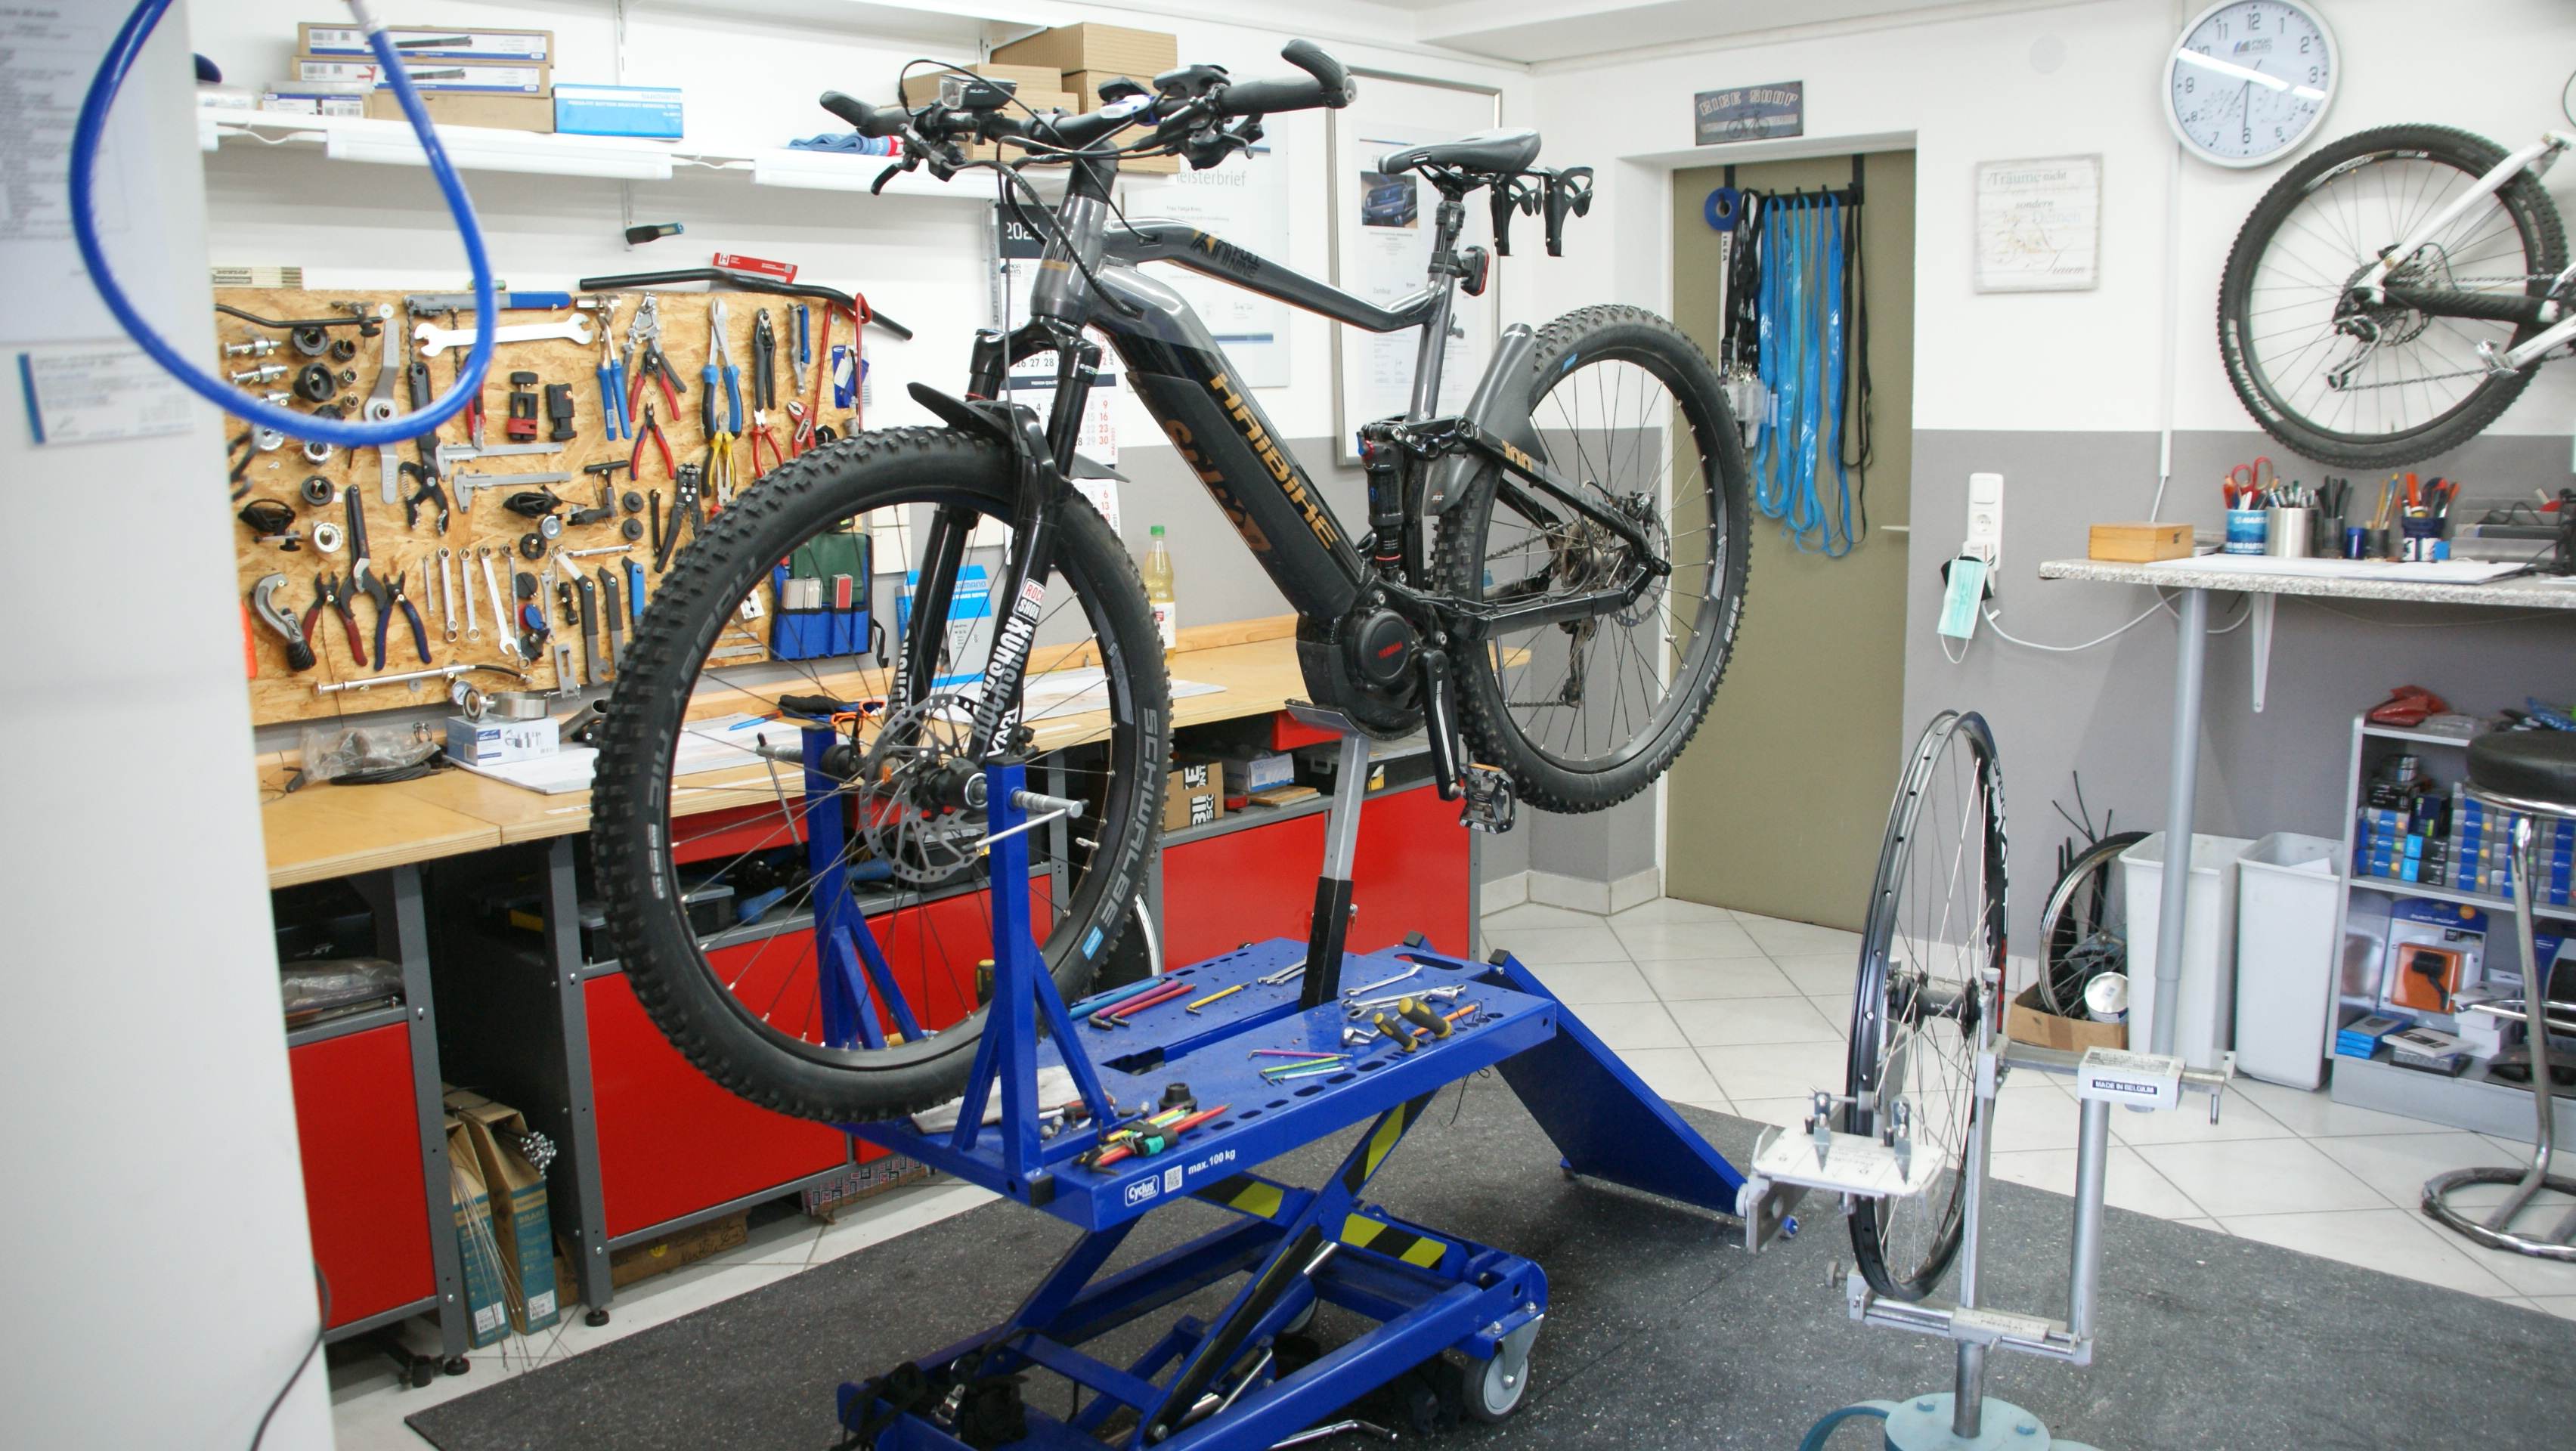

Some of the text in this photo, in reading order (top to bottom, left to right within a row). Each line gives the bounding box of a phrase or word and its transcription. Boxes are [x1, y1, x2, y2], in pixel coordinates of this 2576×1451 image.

[2247, 12, 2261, 30] 12
[2279, 17, 2285, 34] 1
[2217, 23, 2228, 39] 11
[2300, 36, 2310, 54] 2
[2309, 67, 2318, 83] 3
[2186, 77, 2194, 93] 9
[1699, 89, 1798, 116] BIKE SHOP
[2300, 102, 2308, 112] 4
[2191, 111, 2197, 121] 8
[2213, 131, 2219, 141] 7
[2243, 127, 2251, 144] 6
[2275, 126, 2282, 137] 5
[1177, 169, 1246, 187] eisterbrief
[1988, 170, 2067, 186] Träume nicht
[2015, 198, 2054, 209] sondern
[1030, 358, 1039, 367] 27
[1044, 357, 1054, 367] 28
[1103, 401, 1108, 409] 9
[1087, 413, 1108, 422] 15 16
[1085, 424, 1108, 433] 22 23
[1086, 437, 1096, 446] 29
[1099, 436, 1109, 445] 30
[1209, 373, 1339, 550] HAIBIKE
[1104, 490, 1109, 499] 6
[1101, 501, 1110, 511] 13
[1019, 599, 1041, 618] SHOX
[1646, 647, 1726, 776] NOBBY NIC
[986, 701, 1019, 756] YARI
[1253, 761, 1264, 770] 100
[1101, 707, 1159, 928] SCHWALBE
[2095, 1081, 2154, 1094] MADE IN BELGIUM
[1187, 1149, 1236, 1175] max. 100 kg
[1128, 1182, 1155, 1202] Cyclus
[518, 1211, 546, 1224] BRAKE
